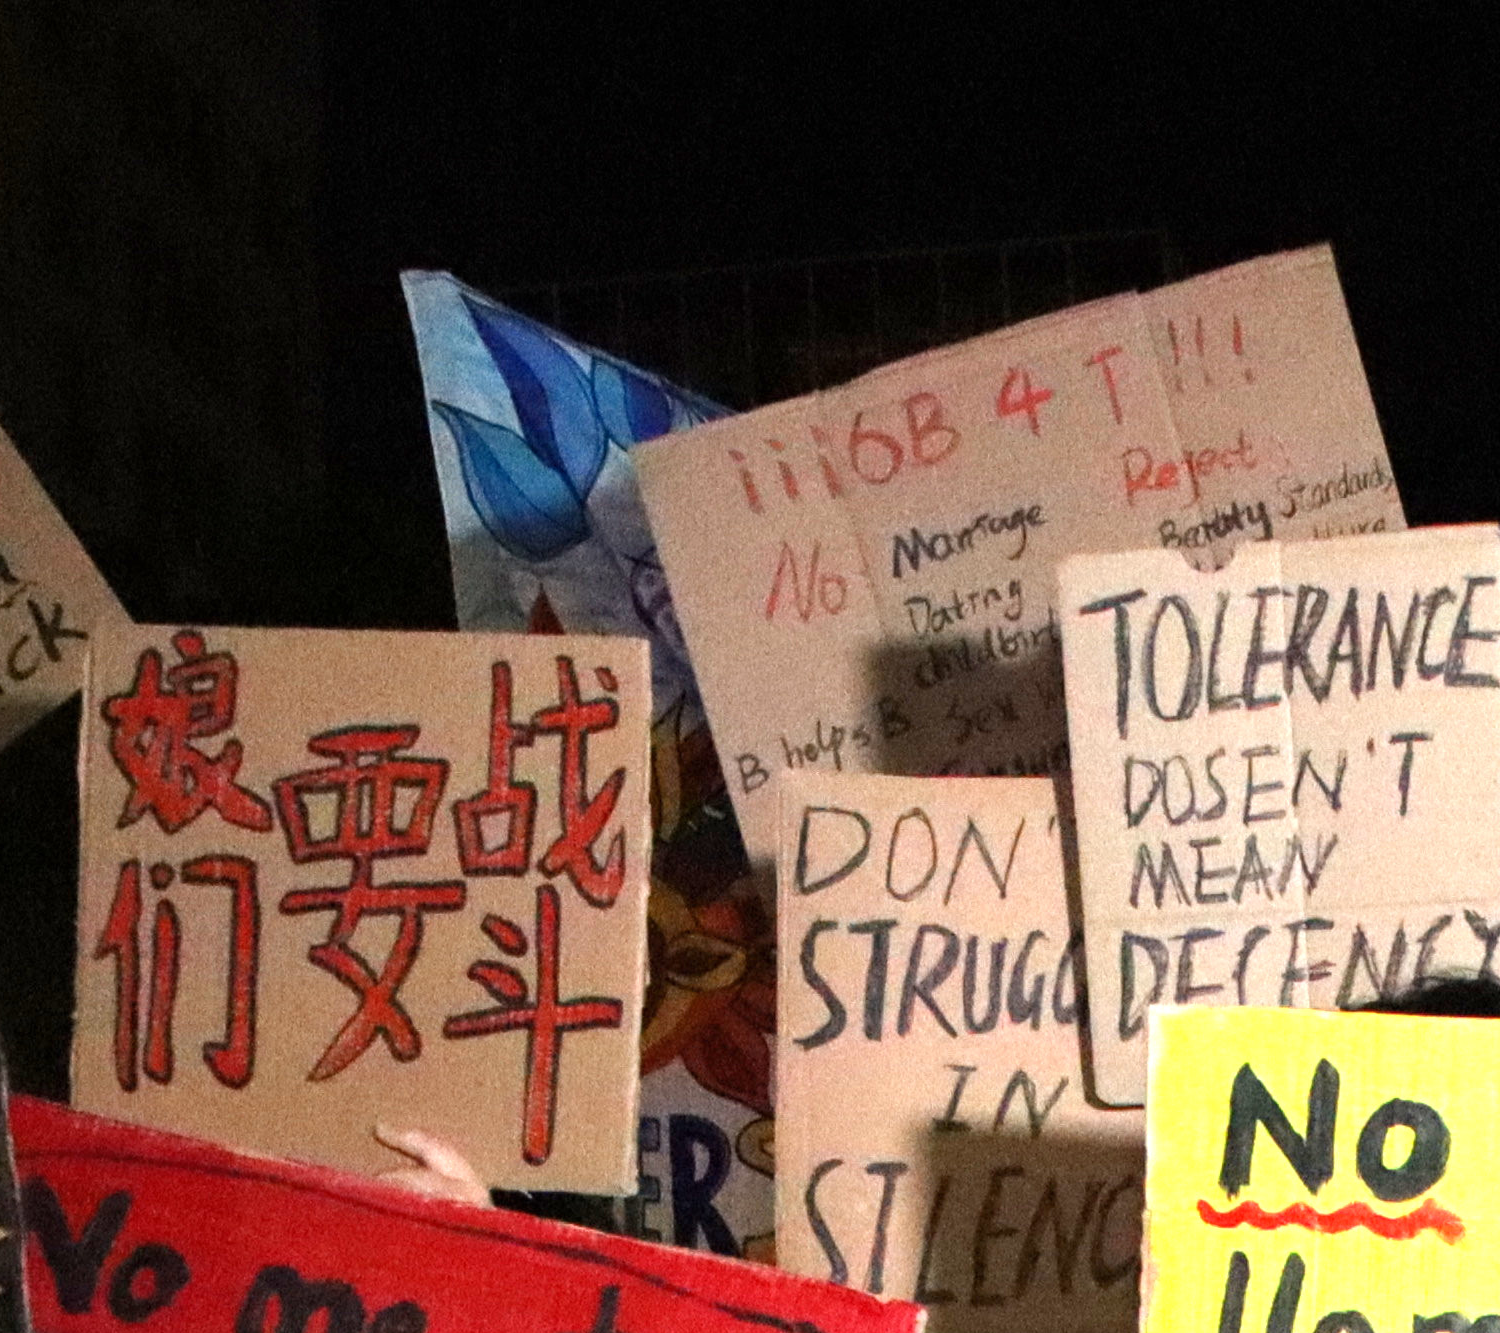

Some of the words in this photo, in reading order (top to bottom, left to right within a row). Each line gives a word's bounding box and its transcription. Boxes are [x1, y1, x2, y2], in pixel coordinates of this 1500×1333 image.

[1122, 429, 1257, 506] Reject
[764, 540, 848, 622] No
[904, 579, 1023, 635] Dating
[1124, 731, 1433, 829] DOSEN'T
[793, 805, 1060, 908] DON'
[1127, 832, 1339, 909] MEAN
[931, 1062, 1070, 1141] IN
[1218, 1058, 1451, 1203] No
[804, 1157, 1143, 1308] SILENC
